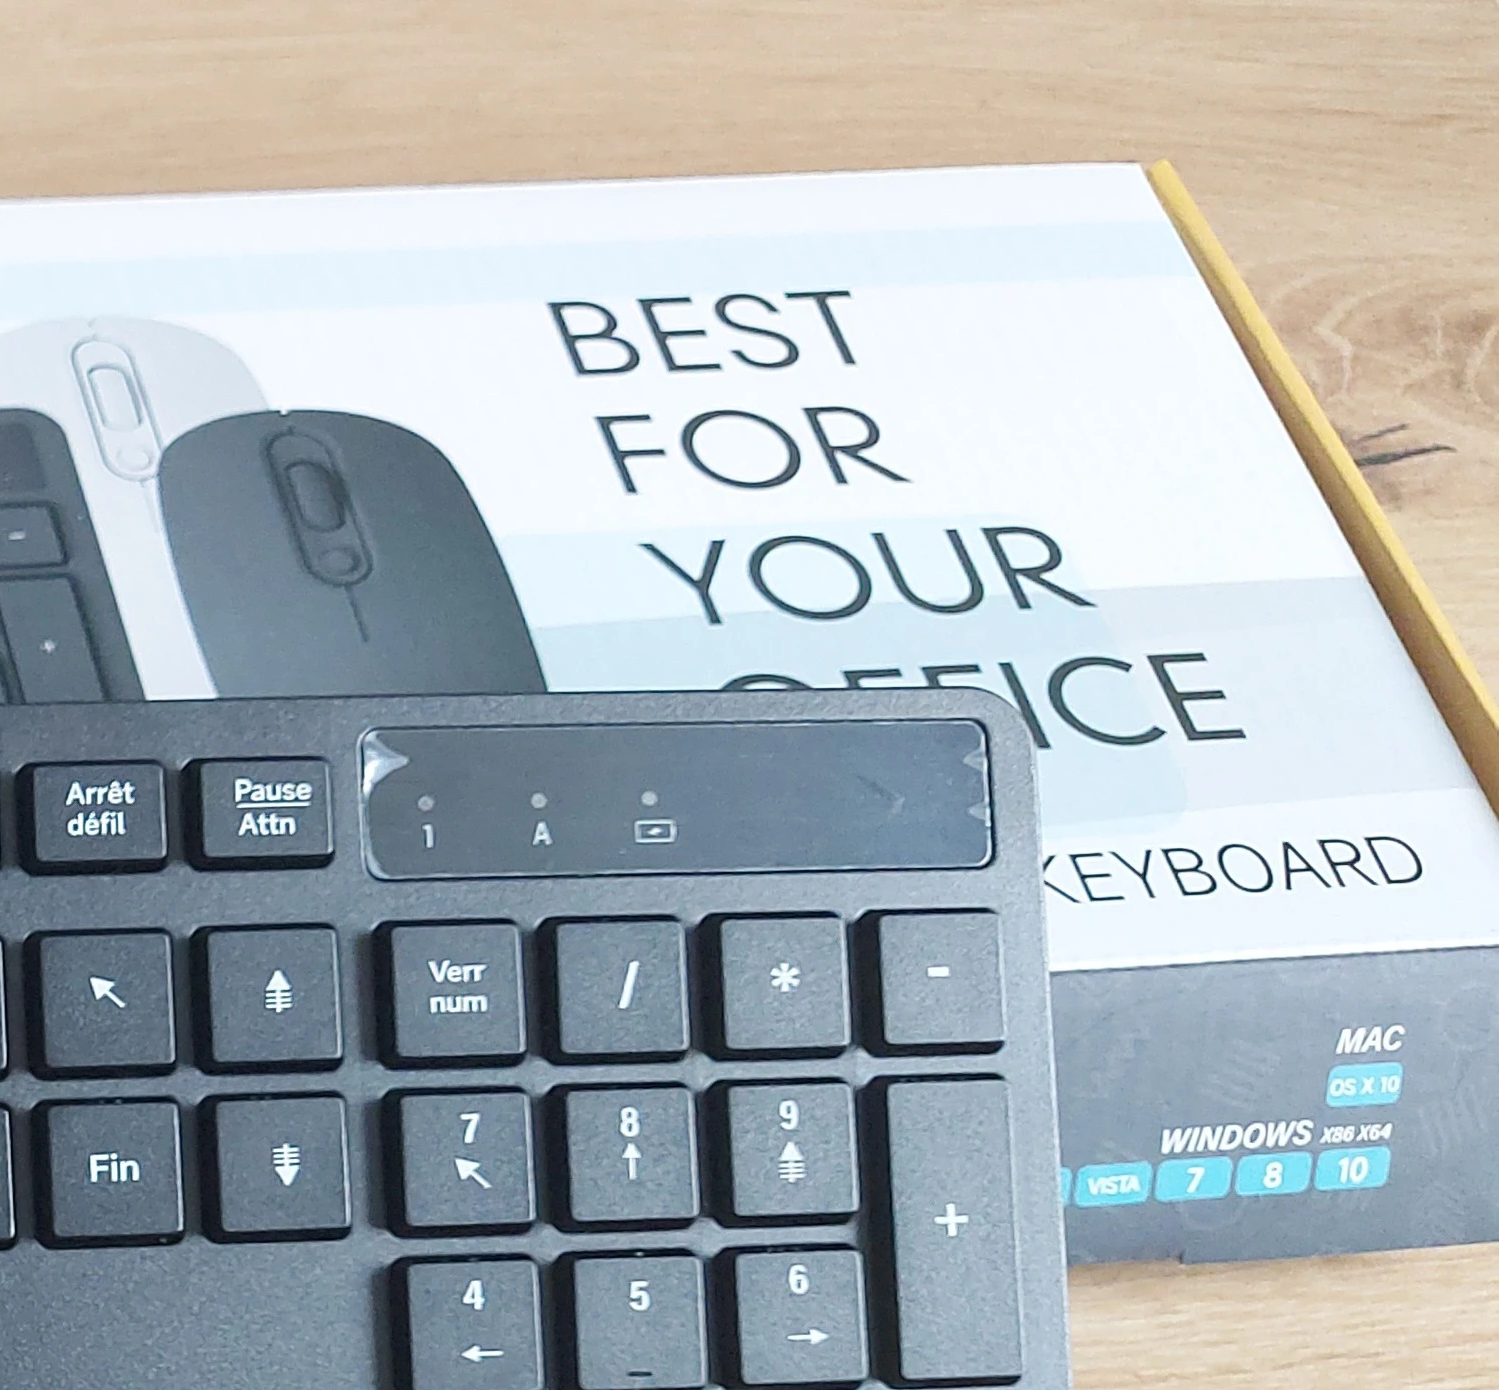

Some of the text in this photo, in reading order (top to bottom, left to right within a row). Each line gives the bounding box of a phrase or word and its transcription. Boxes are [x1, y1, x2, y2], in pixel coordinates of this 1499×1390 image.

[547, 290, 856, 375] BEST
[594, 406, 913, 494] FOR
[639, 527, 1098, 625] YOUR
[720, 652, 1247, 749] ICE
[65, 780, 136, 806] Arrêt
[233, 779, 312, 802] Pause
[67, 811, 126, 837] défil
[238, 812, 296, 836] Attn
[422, 824, 434, 848] 1
[532, 822, 552, 845] A
[428, 959, 487, 983] Verr
[429, 995, 488, 1014] num
[1335, 1025, 1405, 1054] MAC
[1330, 1075, 1400, 1097] OS X 10
[460, 1113, 480, 1144] 7
[620, 1106, 640, 1138] 8
[779, 1100, 799, 1130] 9
[1160, 1119, 1393, 1154] WINDOWS X86 X64
[89, 1152, 140, 1183] Fin
[1087, 1155, 1369, 1197] VISTA 7 8 10
[788, 1264, 809, 1295] 6
[462, 1280, 485, 1310] 4
[629, 1280, 650, 1311] 5
